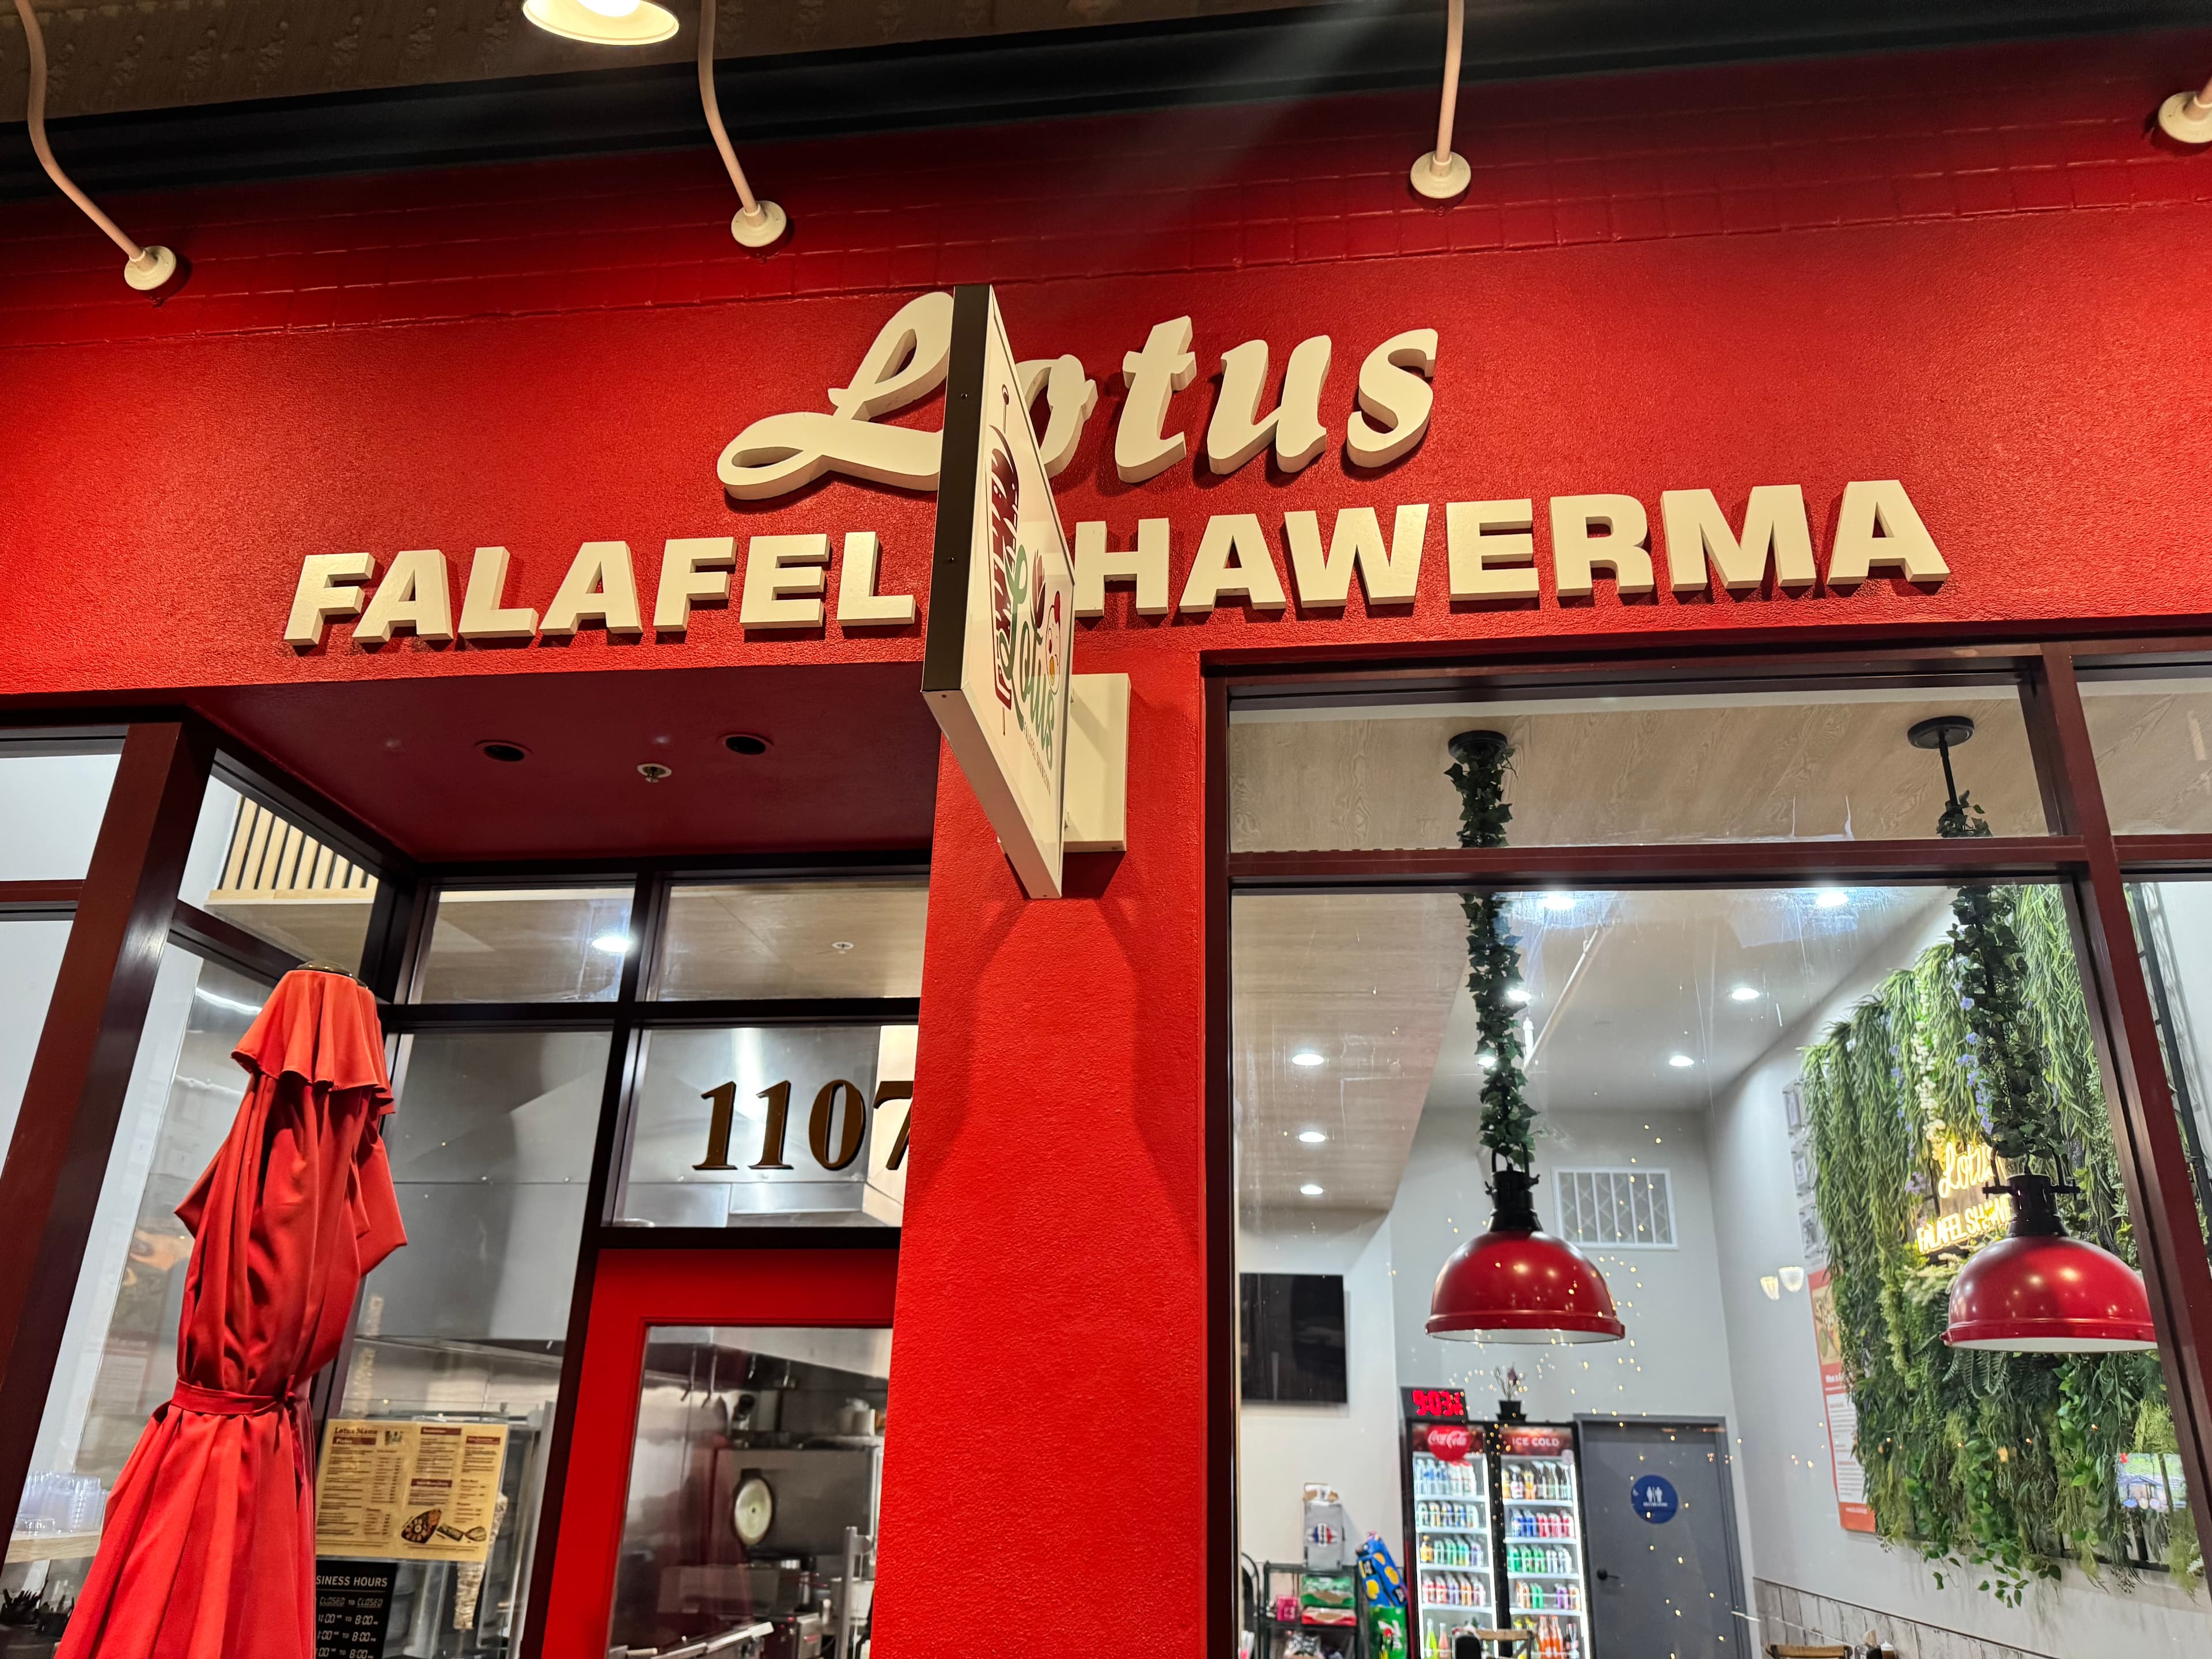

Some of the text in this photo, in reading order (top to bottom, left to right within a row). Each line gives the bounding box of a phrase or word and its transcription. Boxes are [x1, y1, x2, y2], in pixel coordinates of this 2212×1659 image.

[283, 479, 1950, 647] FALAFEL HAWERMA
[998, 544, 1054, 770] Lotus
[692, 1079, 915, 1171] 1107
[1512, 1437, 1560, 1448] ICE COLD
[316, 1575, 388, 1587] SINESS HOURS
[320, 1596, 346, 1606] CLOSED
[357, 1597, 384, 1608] CLOSED
[355, 1615, 373, 1625] 8:00
[317, 1630, 333, 1640] 1:00
[352, 1631, 370, 1642] 8:00
